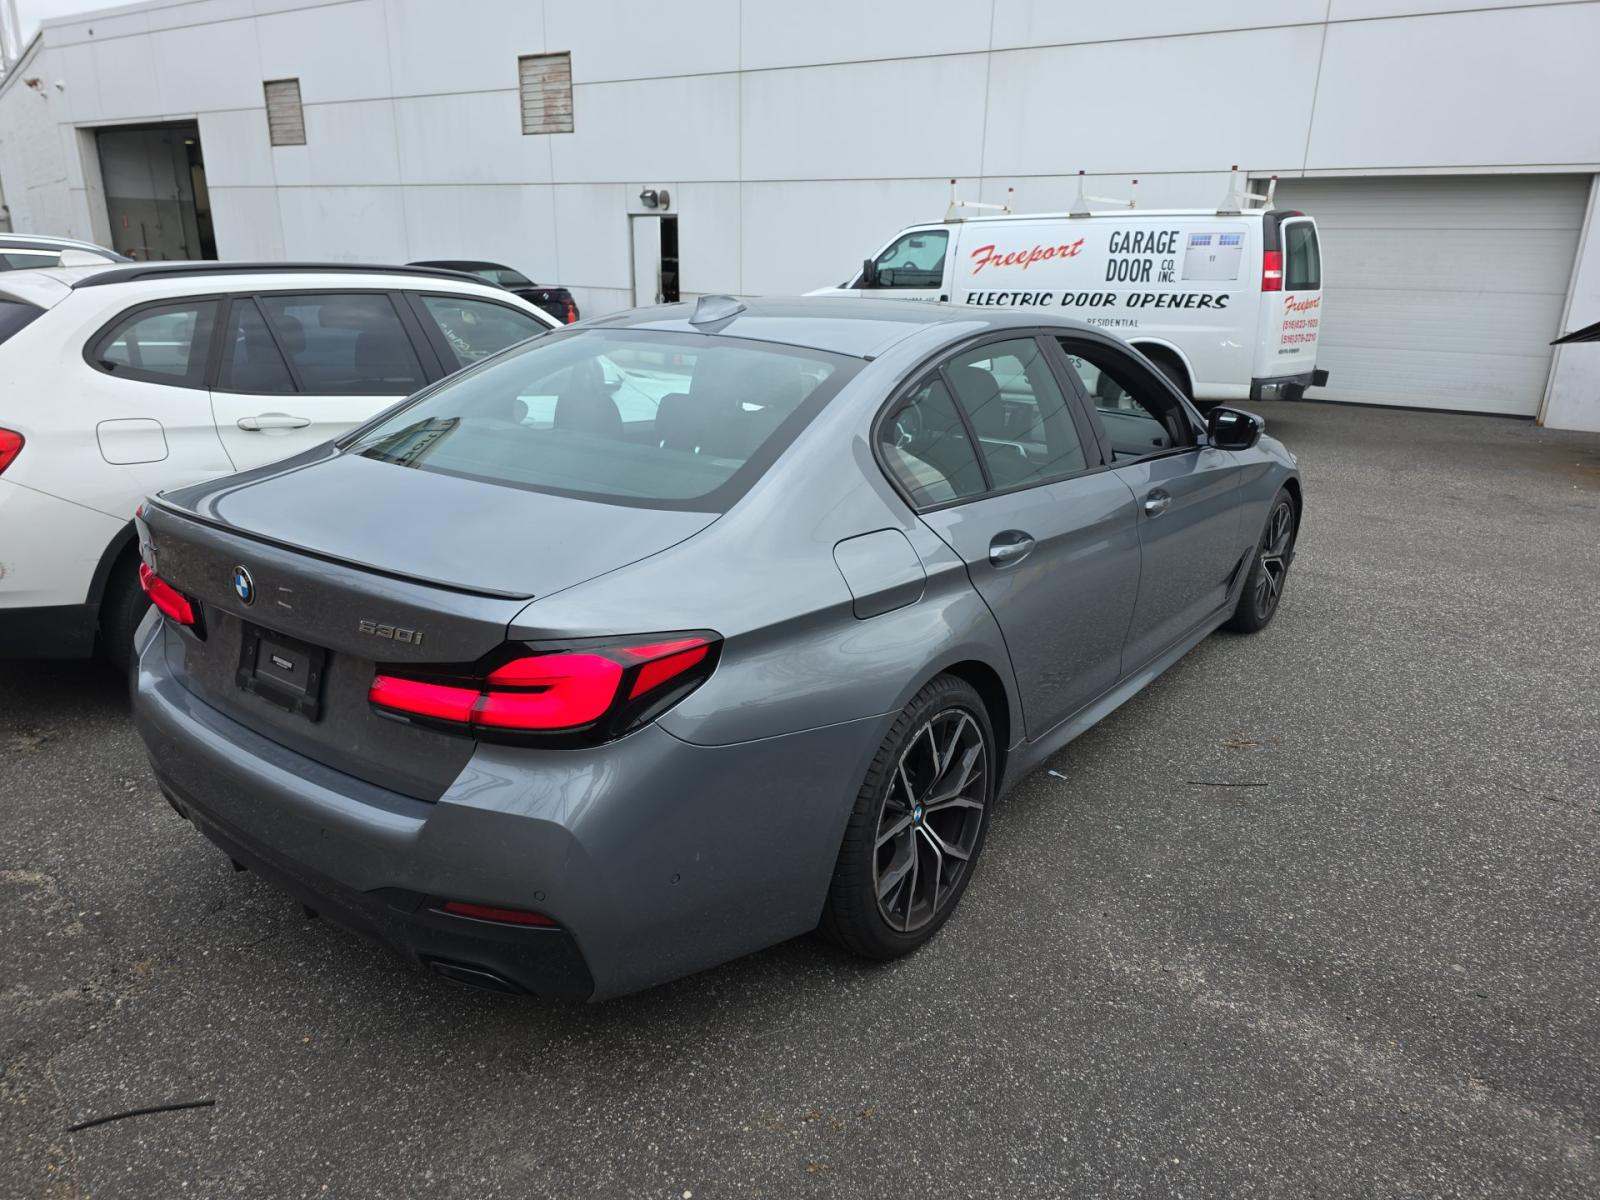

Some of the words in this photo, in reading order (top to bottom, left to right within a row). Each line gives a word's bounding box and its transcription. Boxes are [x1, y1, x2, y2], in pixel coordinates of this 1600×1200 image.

[1109, 231, 1179, 254] GARAGE
[970, 238, 1084, 275] Freeport
[1161, 259, 1176, 270] CO.
[1106, 259, 1153, 282] DOOR
[1158, 272, 1176, 283] INC.
[966, 292, 1052, 306] ELECTRIC
[1061, 293, 1116, 307] DOOR
[1126, 293, 1229, 309] OPENERS
[1284, 296, 1319, 315] Freeport
[1087, 318, 1138, 327] RESIDENTIAL
